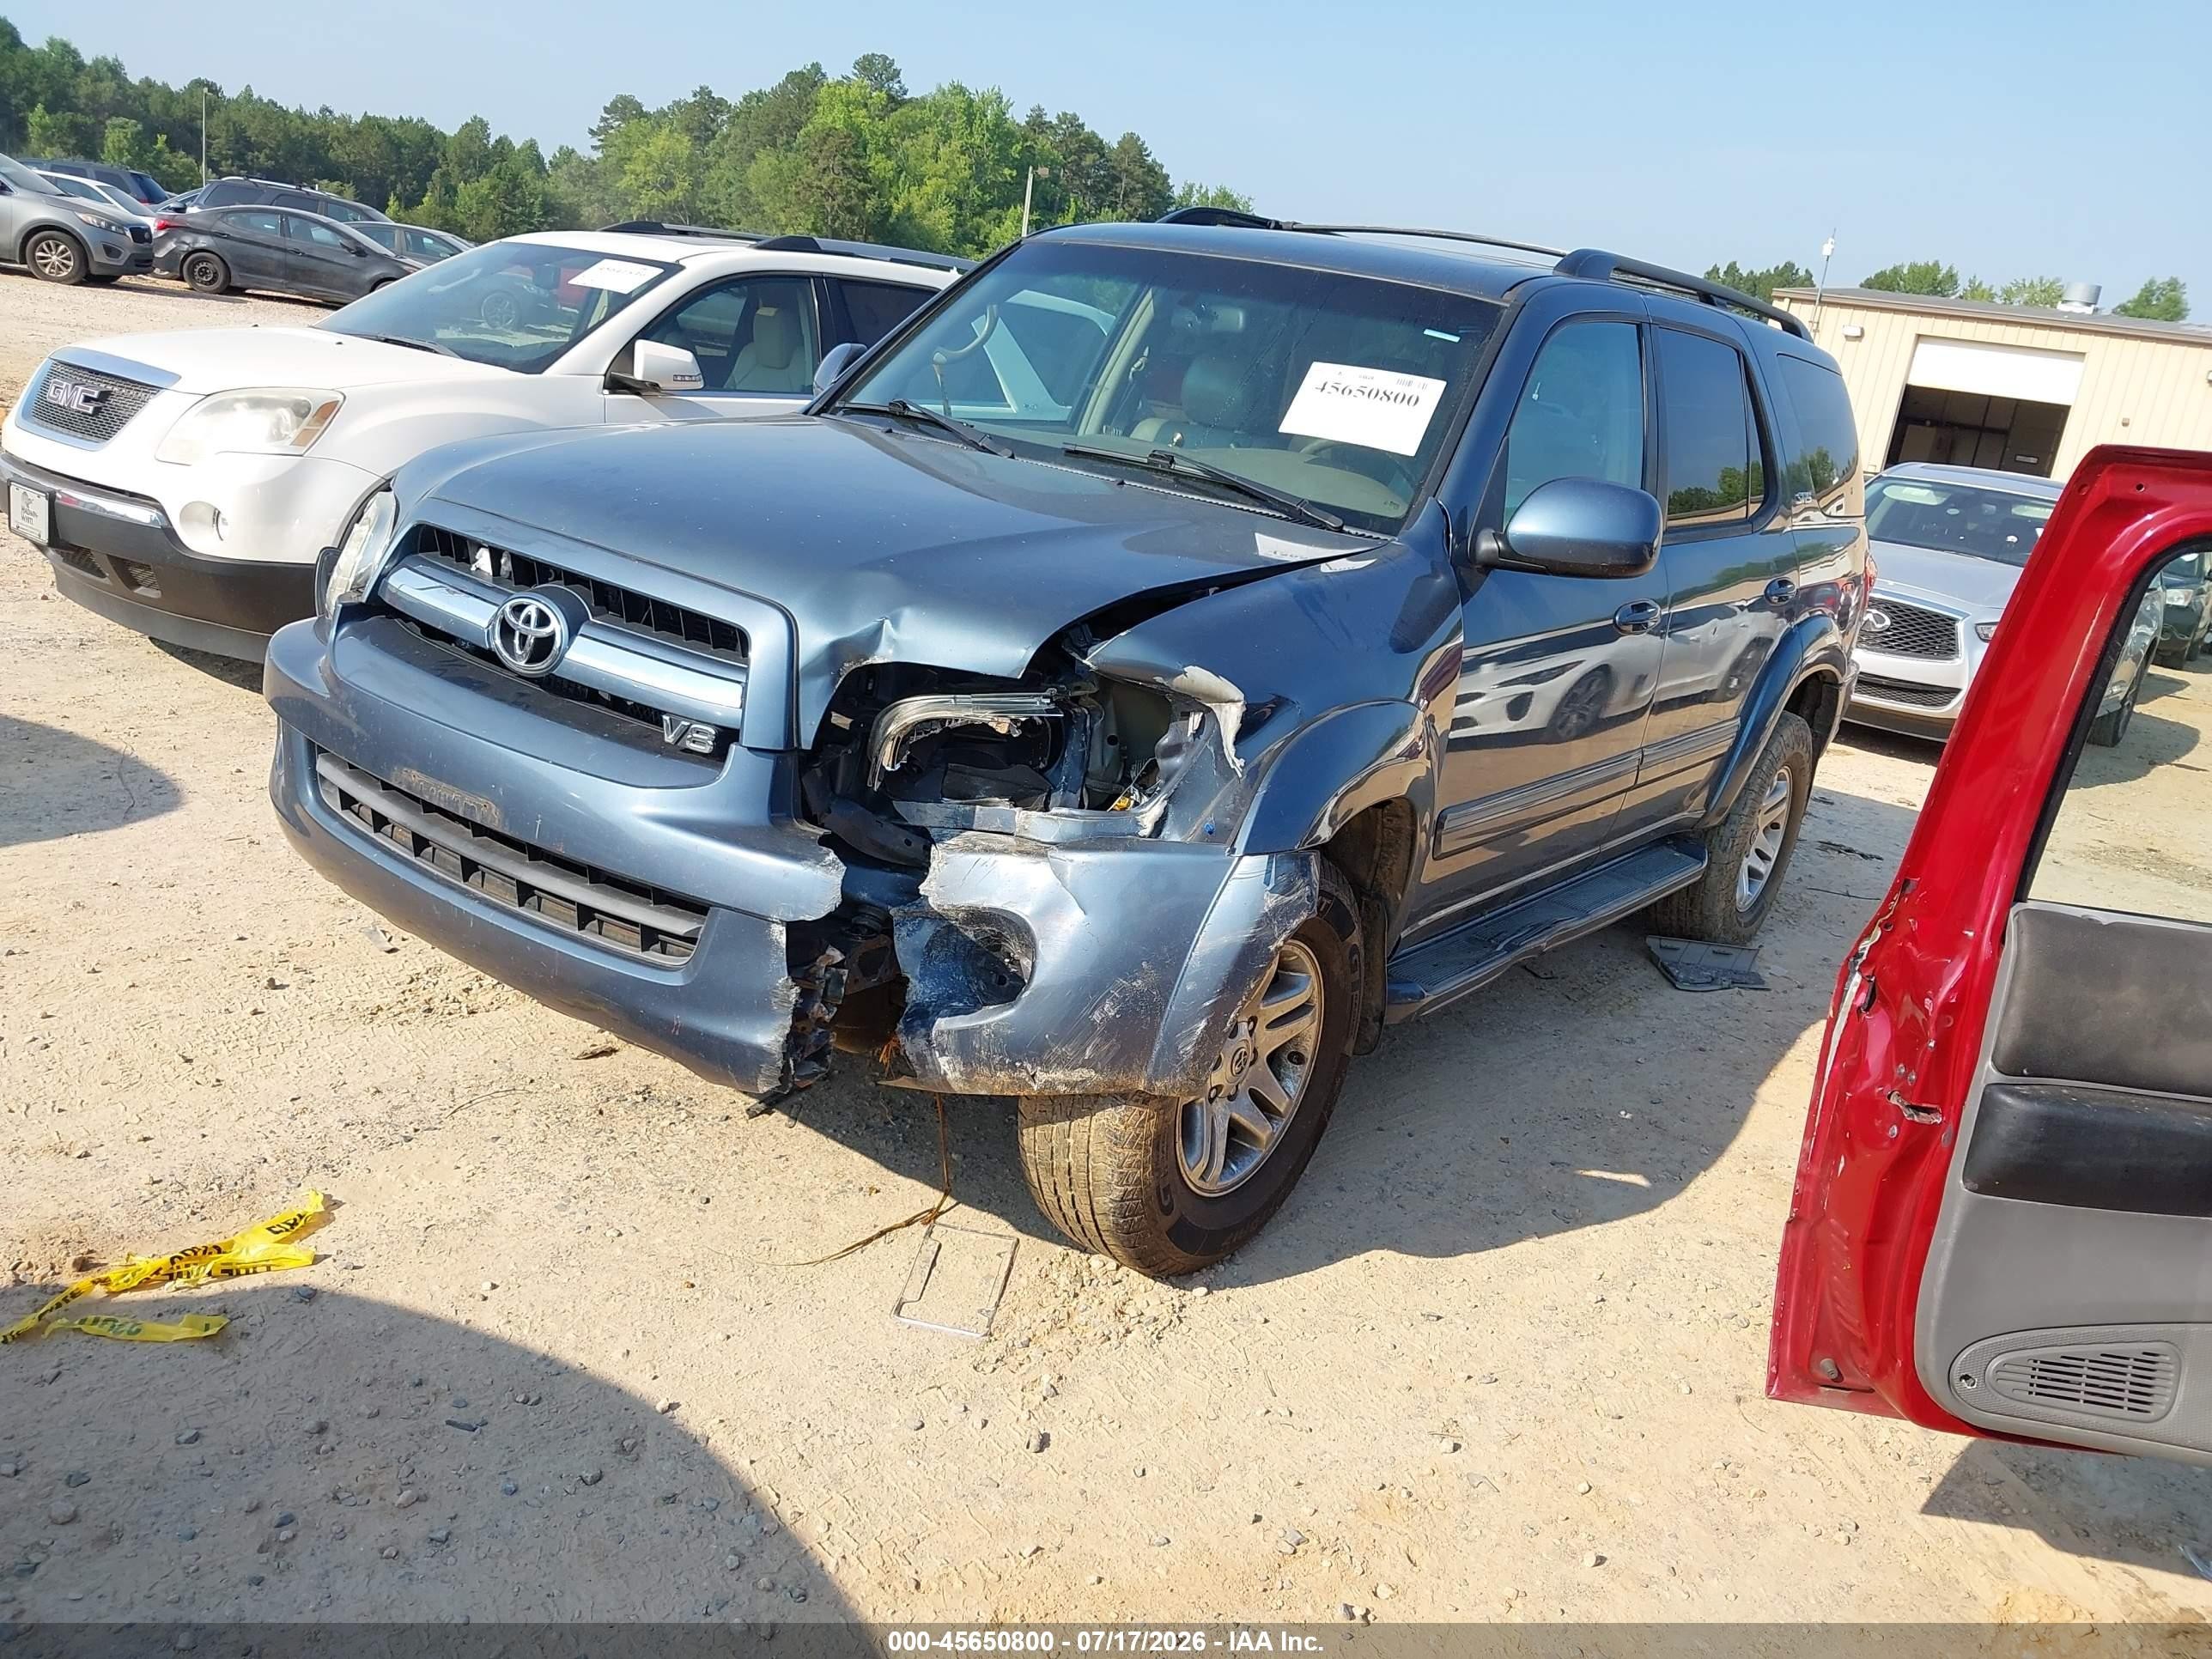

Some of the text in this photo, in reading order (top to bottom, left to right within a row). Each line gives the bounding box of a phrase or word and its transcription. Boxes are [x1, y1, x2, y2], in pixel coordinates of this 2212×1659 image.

[47, 379, 100, 414] GMC
[1315, 380, 1419, 406] 45650800
[662, 714, 716, 753] V8
